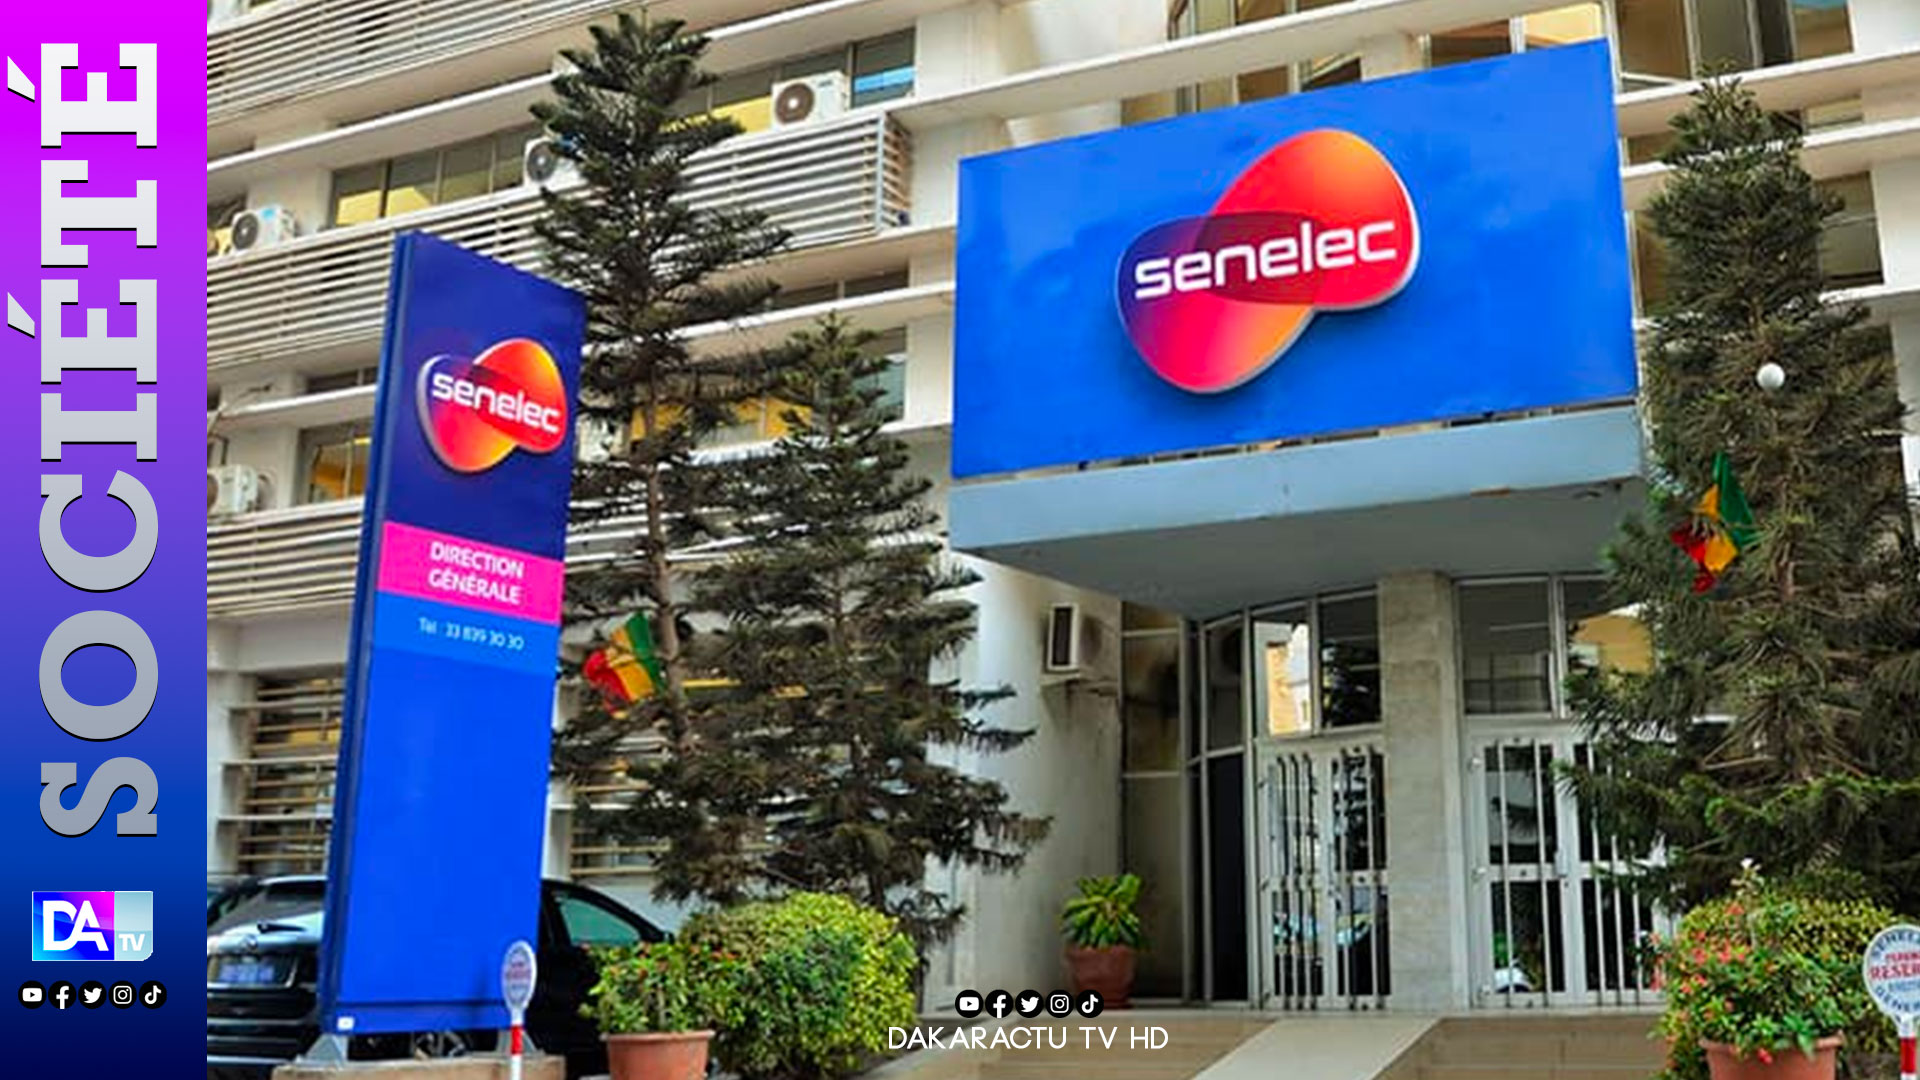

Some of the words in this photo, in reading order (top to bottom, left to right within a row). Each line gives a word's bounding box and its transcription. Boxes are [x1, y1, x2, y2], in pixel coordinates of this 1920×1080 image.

[1135, 219, 1397, 299] senelec
[431, 371, 561, 434] senelec
[429, 540, 525, 579] DIRECTION
[427, 568, 522, 605] GÉNÉRALE
[508, 633, 525, 651] 30
